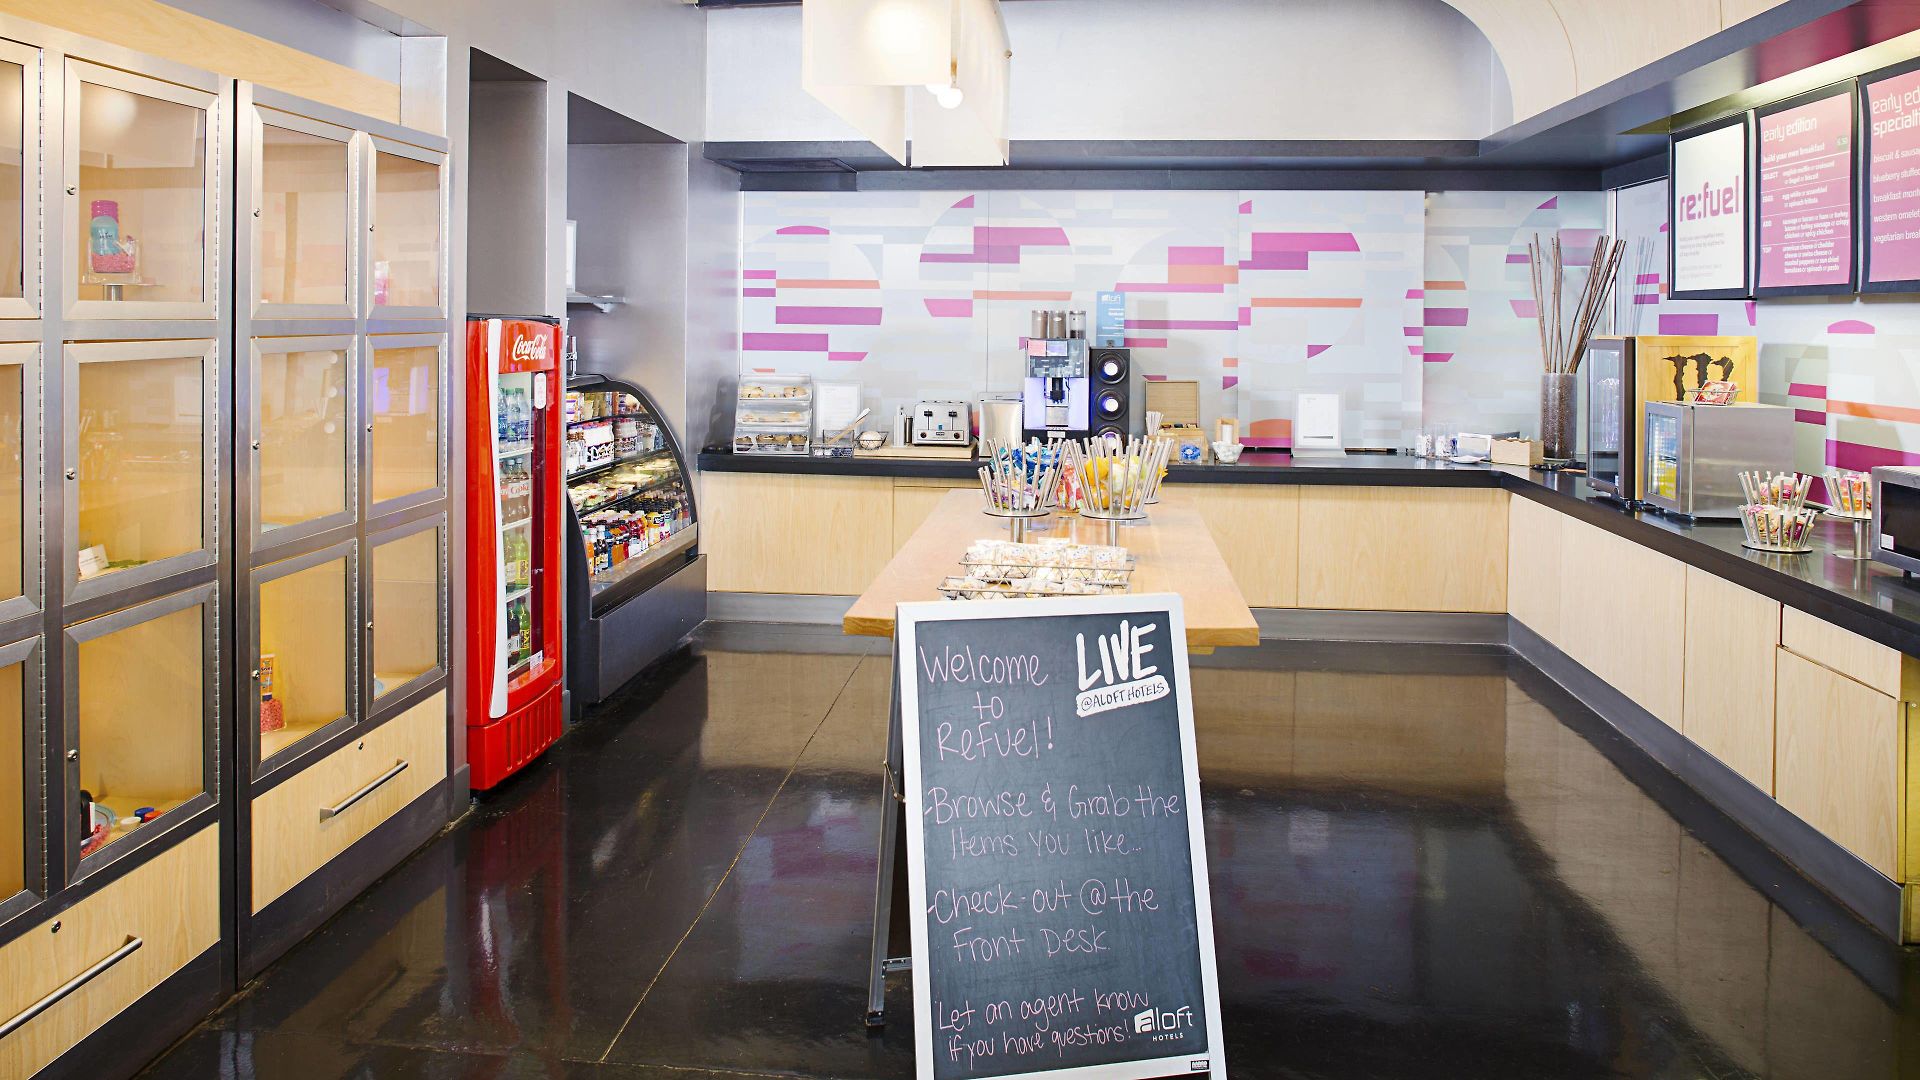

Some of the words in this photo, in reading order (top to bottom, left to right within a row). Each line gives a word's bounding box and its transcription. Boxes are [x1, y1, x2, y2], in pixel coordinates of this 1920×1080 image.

[1872, 92, 1902, 114] early
[1763, 123, 1785, 142] early
[1786, 116, 1817, 136] edition
[1800, 143, 1825, 156] breakfast
[1873, 151, 1894, 163] biscuit
[1894, 149, 1900, 159] &
[1872, 171, 1901, 184] blueberry
[1679, 175, 1740, 222] re:fuel
[1873, 191, 1902, 203] breakfast
[1873, 213, 1898, 223] western
[1873, 231, 1904, 244] vegetarian
[512, 334, 548, 361] Coca-Cola
[919, 645, 1049, 686] Welcome
[1075, 620, 1158, 691] LIVE
[972, 691, 1004, 720] to
[1081, 690, 1126, 712] @ALOFT
[1127, 682, 1165, 701] HOTELS
[1041, 782, 1057, 821] &
[1069, 784, 1130, 819] Grab
[1134, 784, 1180, 818] the
[951, 827, 1018, 861] Items
[1080, 878, 1106, 915] @
[1110, 878, 1159, 912] the
[953, 926, 1026, 962] Front
[938, 1000, 976, 1032] Let
[985, 1000, 1012, 1025] an
[1020, 988, 1085, 1032] agent
[1094, 988, 1149, 1014] know
[1134, 1006, 1193, 1034] aloft
[948, 1034, 963, 1062] if
[967, 1038, 994, 1071] you
[1003, 1031, 1044, 1056] have
[1051, 1020, 1131, 1058] questions!
[1152, 1032, 1184, 1042] HOTELS
